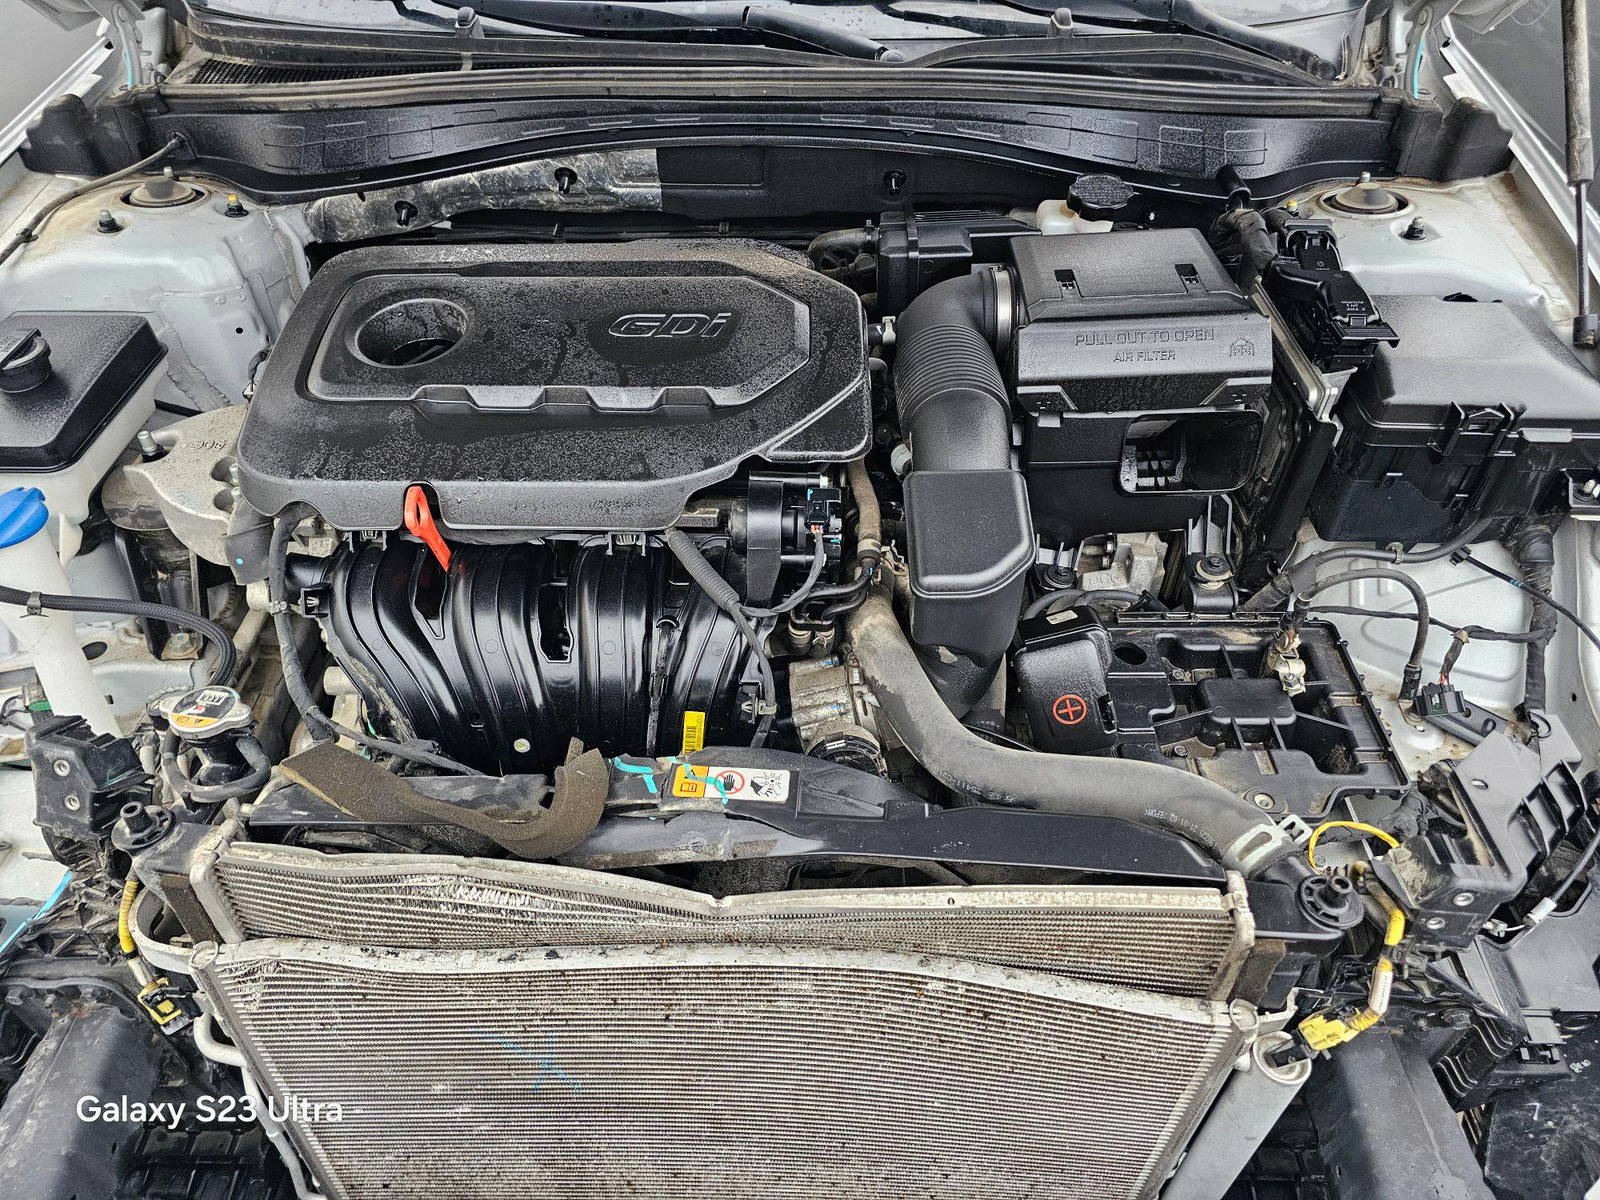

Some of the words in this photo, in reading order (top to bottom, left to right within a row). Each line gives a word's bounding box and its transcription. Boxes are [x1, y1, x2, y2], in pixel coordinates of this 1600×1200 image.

[608, 312, 732, 338] GDi
[1075, 332, 1113, 346] PULL
[1116, 330, 1147, 345] OUT
[1150, 329, 1171, 344] TO
[1174, 328, 1216, 343] OPEN
[1113, 351, 1134, 363] AIR
[1136, 350, 1177, 362] FILTER
